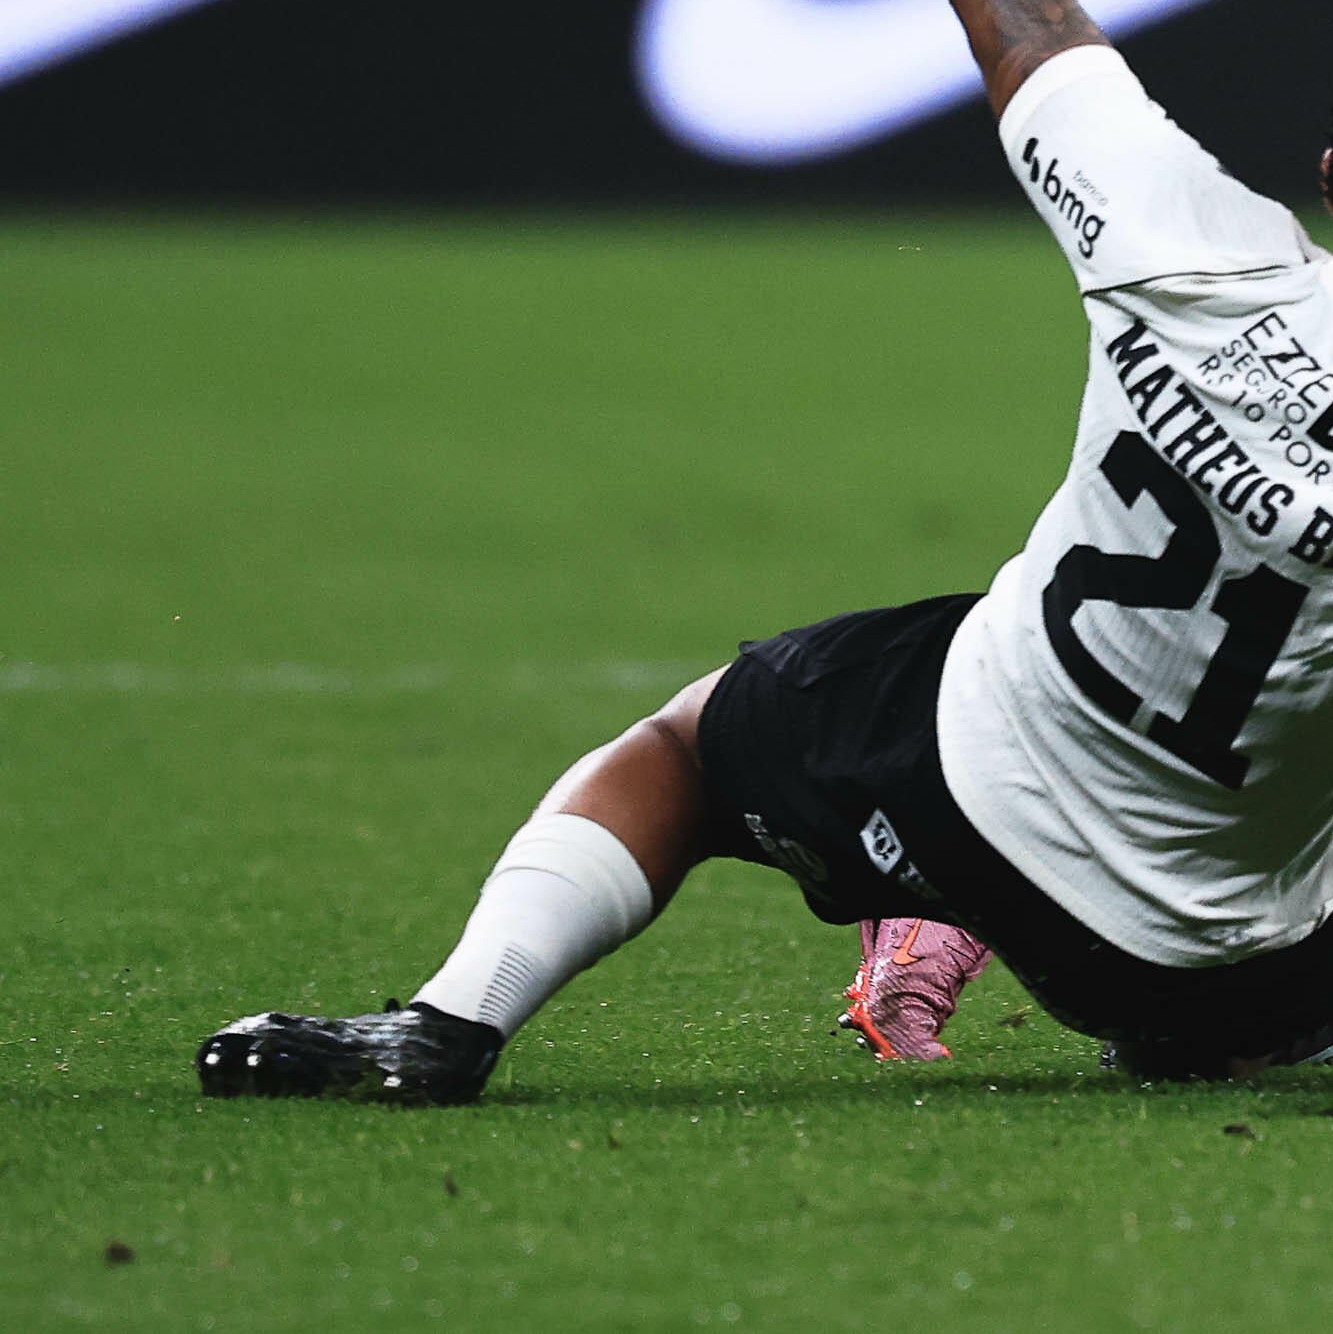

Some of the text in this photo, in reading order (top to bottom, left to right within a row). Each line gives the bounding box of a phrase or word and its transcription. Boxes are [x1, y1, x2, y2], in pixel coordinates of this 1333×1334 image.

[1043, 158, 1106, 259] bmg
[1105, 319, 1295, 540] MATHEUS
[1230, 390, 1266, 423] 10
[1268, 425, 1332, 485] POR
[1043, 429, 1310, 791] 21
